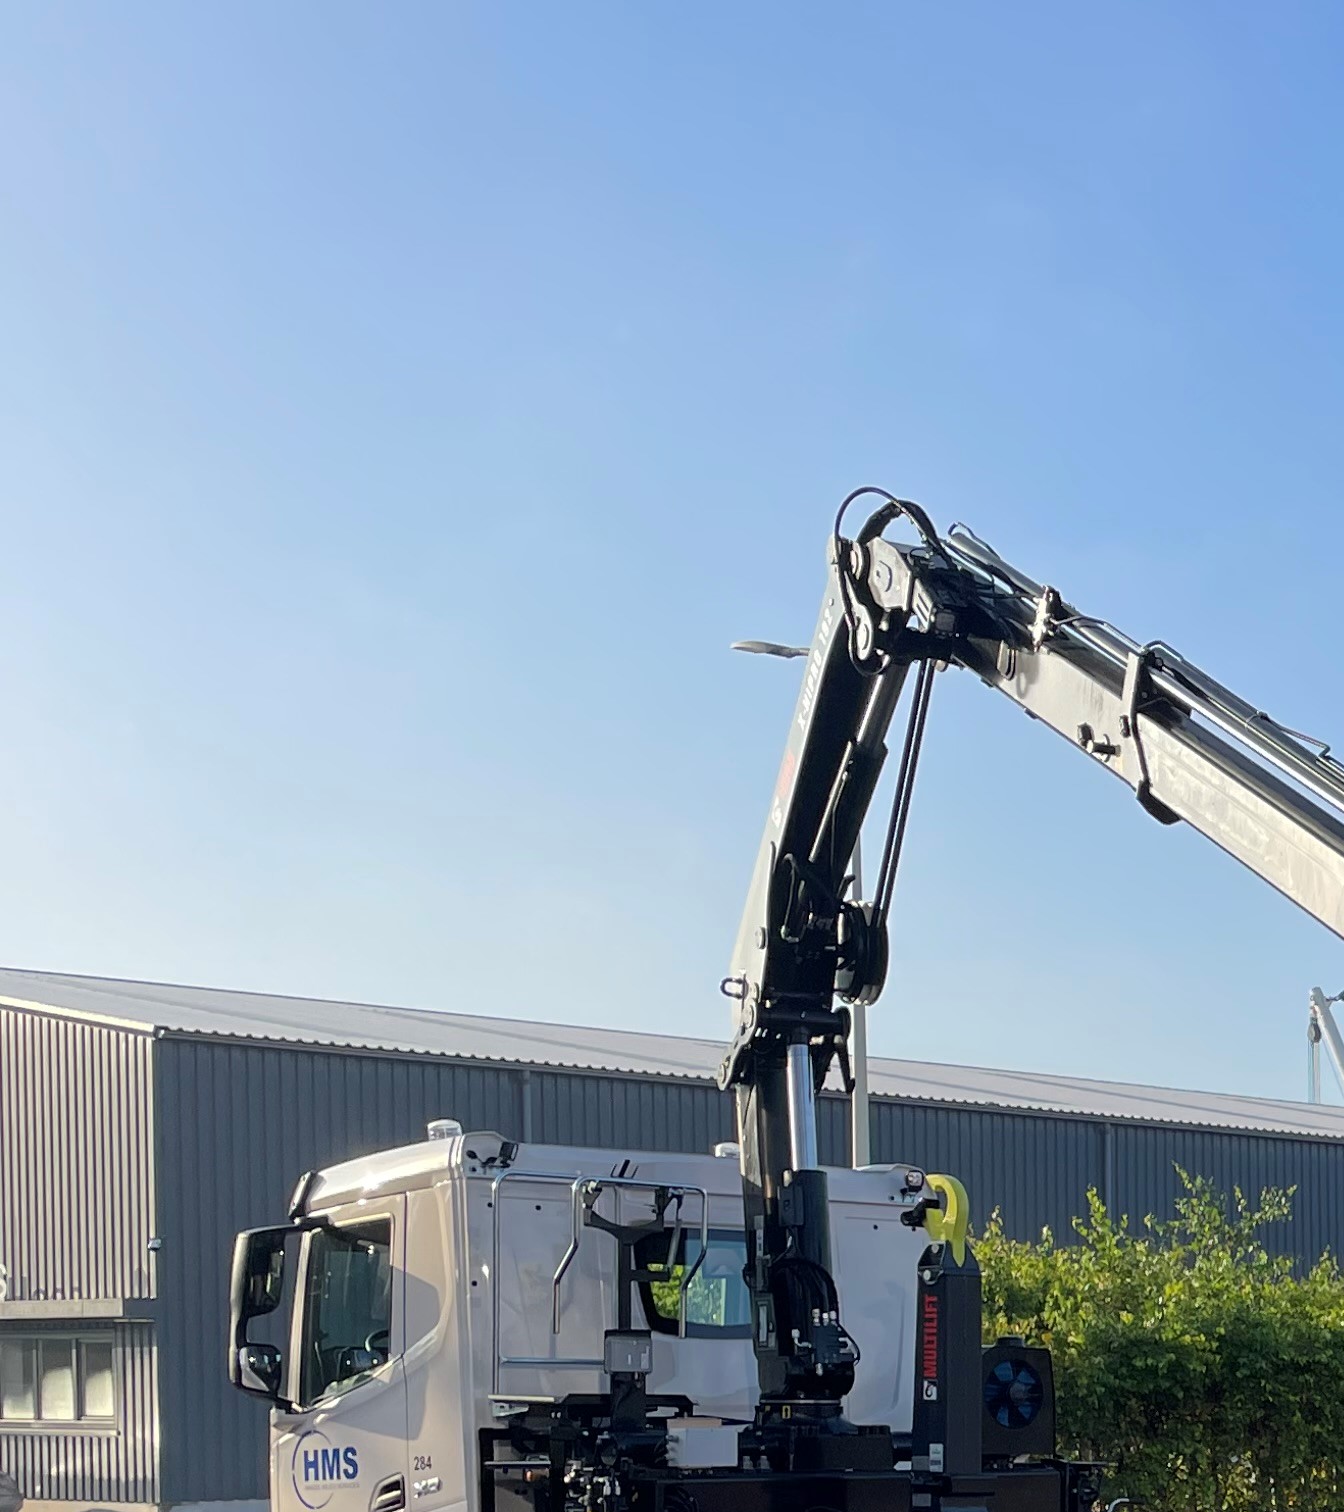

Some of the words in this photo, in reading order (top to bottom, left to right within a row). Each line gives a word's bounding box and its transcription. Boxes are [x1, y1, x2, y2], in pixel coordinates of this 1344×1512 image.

[924, 1294, 938, 1379] MULTILIFT
[303, 1446, 359, 1482] HMS
[414, 1456, 432, 1471] 284
